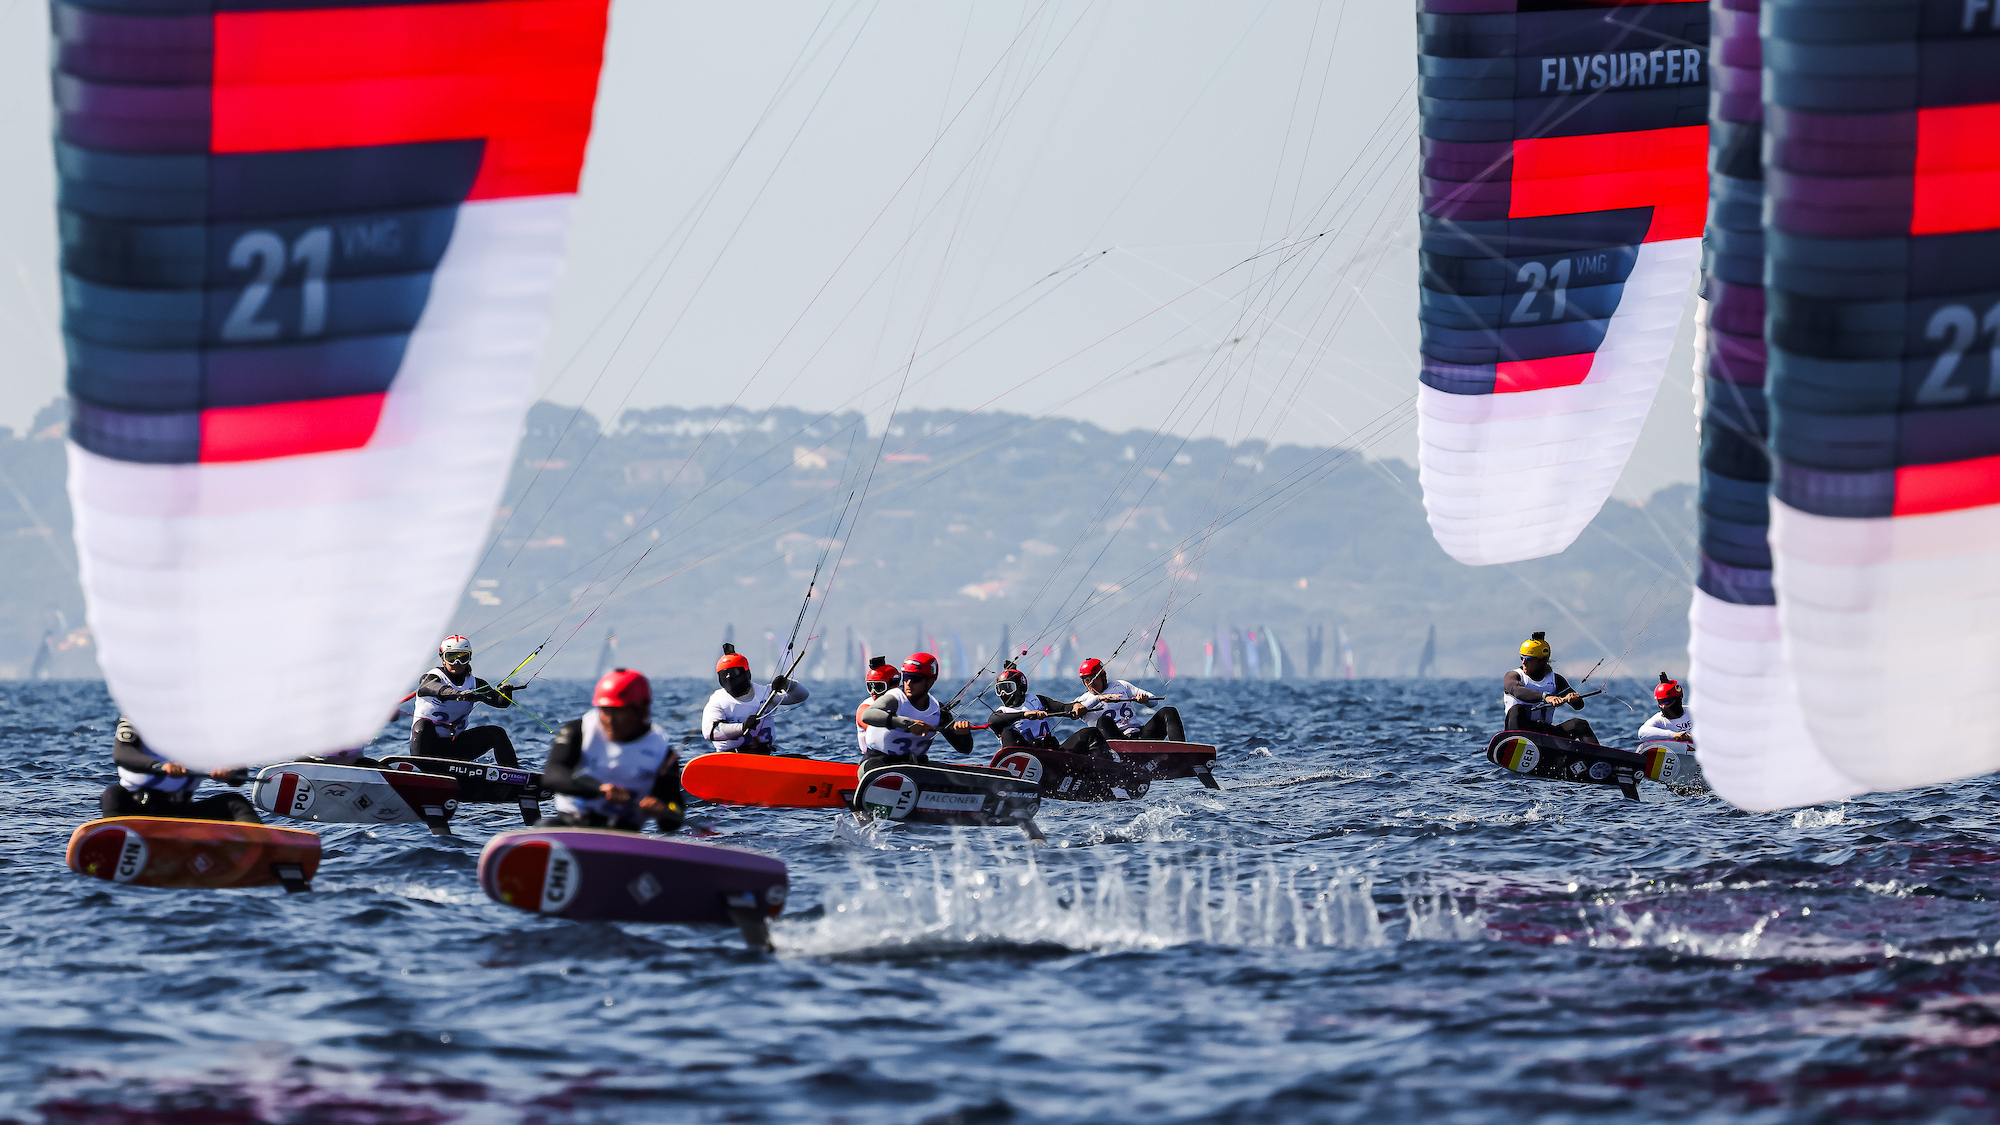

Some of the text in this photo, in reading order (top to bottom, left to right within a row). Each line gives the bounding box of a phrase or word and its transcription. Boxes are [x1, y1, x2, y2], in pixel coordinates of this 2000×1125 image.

[1540, 48, 1701, 92] FLYSURFER
[220, 225, 332, 341] 21
[1509, 254, 1607, 323] 21 VMG
[1521, 749, 1535, 768] GER
[1662, 757, 1676, 778] GER
[294, 785, 311, 811] POL
[324, 789, 347, 798] PGE
[896, 790, 913, 810] ITA
[924, 794, 979, 805] FALCONERI
[119, 842, 142, 877] CHN
[547, 858, 570, 902] CHN
